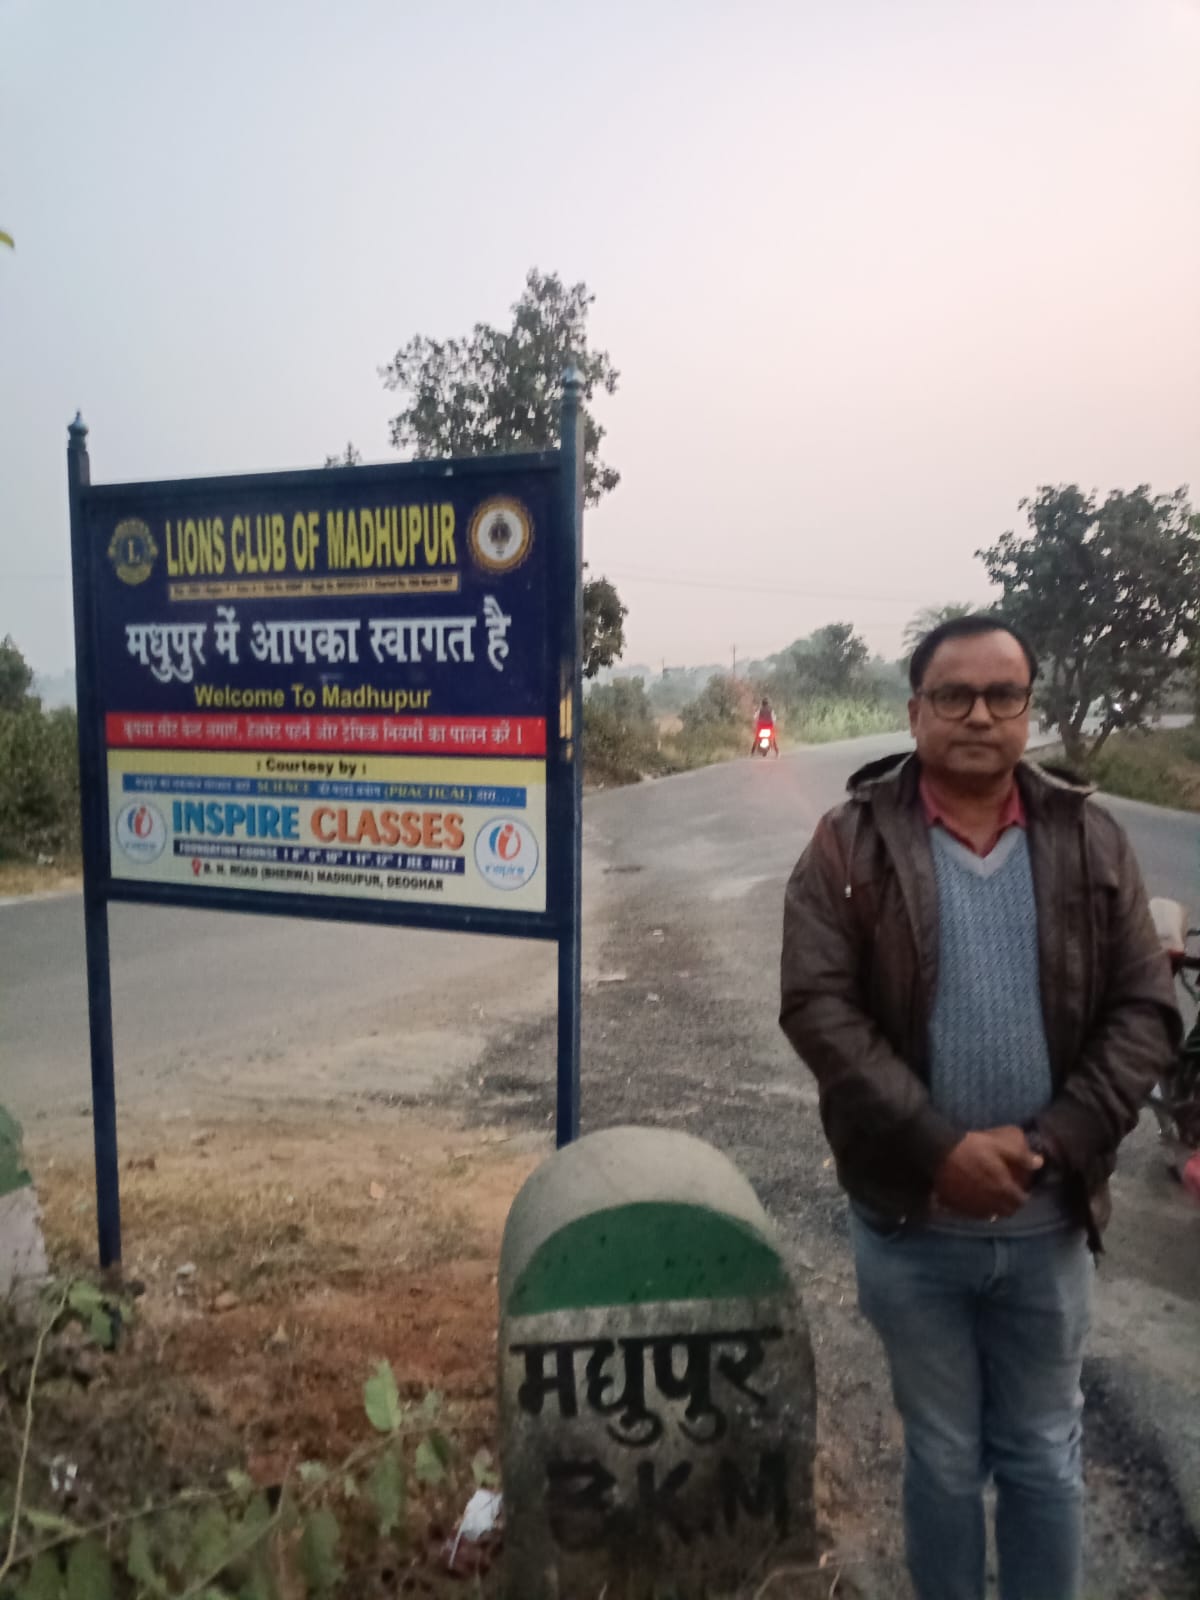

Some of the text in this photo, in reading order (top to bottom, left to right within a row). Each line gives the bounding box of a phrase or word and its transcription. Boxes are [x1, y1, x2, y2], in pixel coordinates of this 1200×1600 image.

[166, 502, 456, 577] LIONS CLUB OF MADHUPUR
[125, 594, 512, 684] मधुपुर में आपका स्वागत है
[194, 684, 432, 714] Welcome To Madhupur
[265, 756, 334, 776] Courtesy
[339, 759, 357, 778] by
[172, 800, 465, 850] INSPIRE CLASSES
[230, 865, 258, 878] ROAD
[387, 875, 443, 890] DEOGHAR
[509, 1328, 782, 1446] मधुपुर
